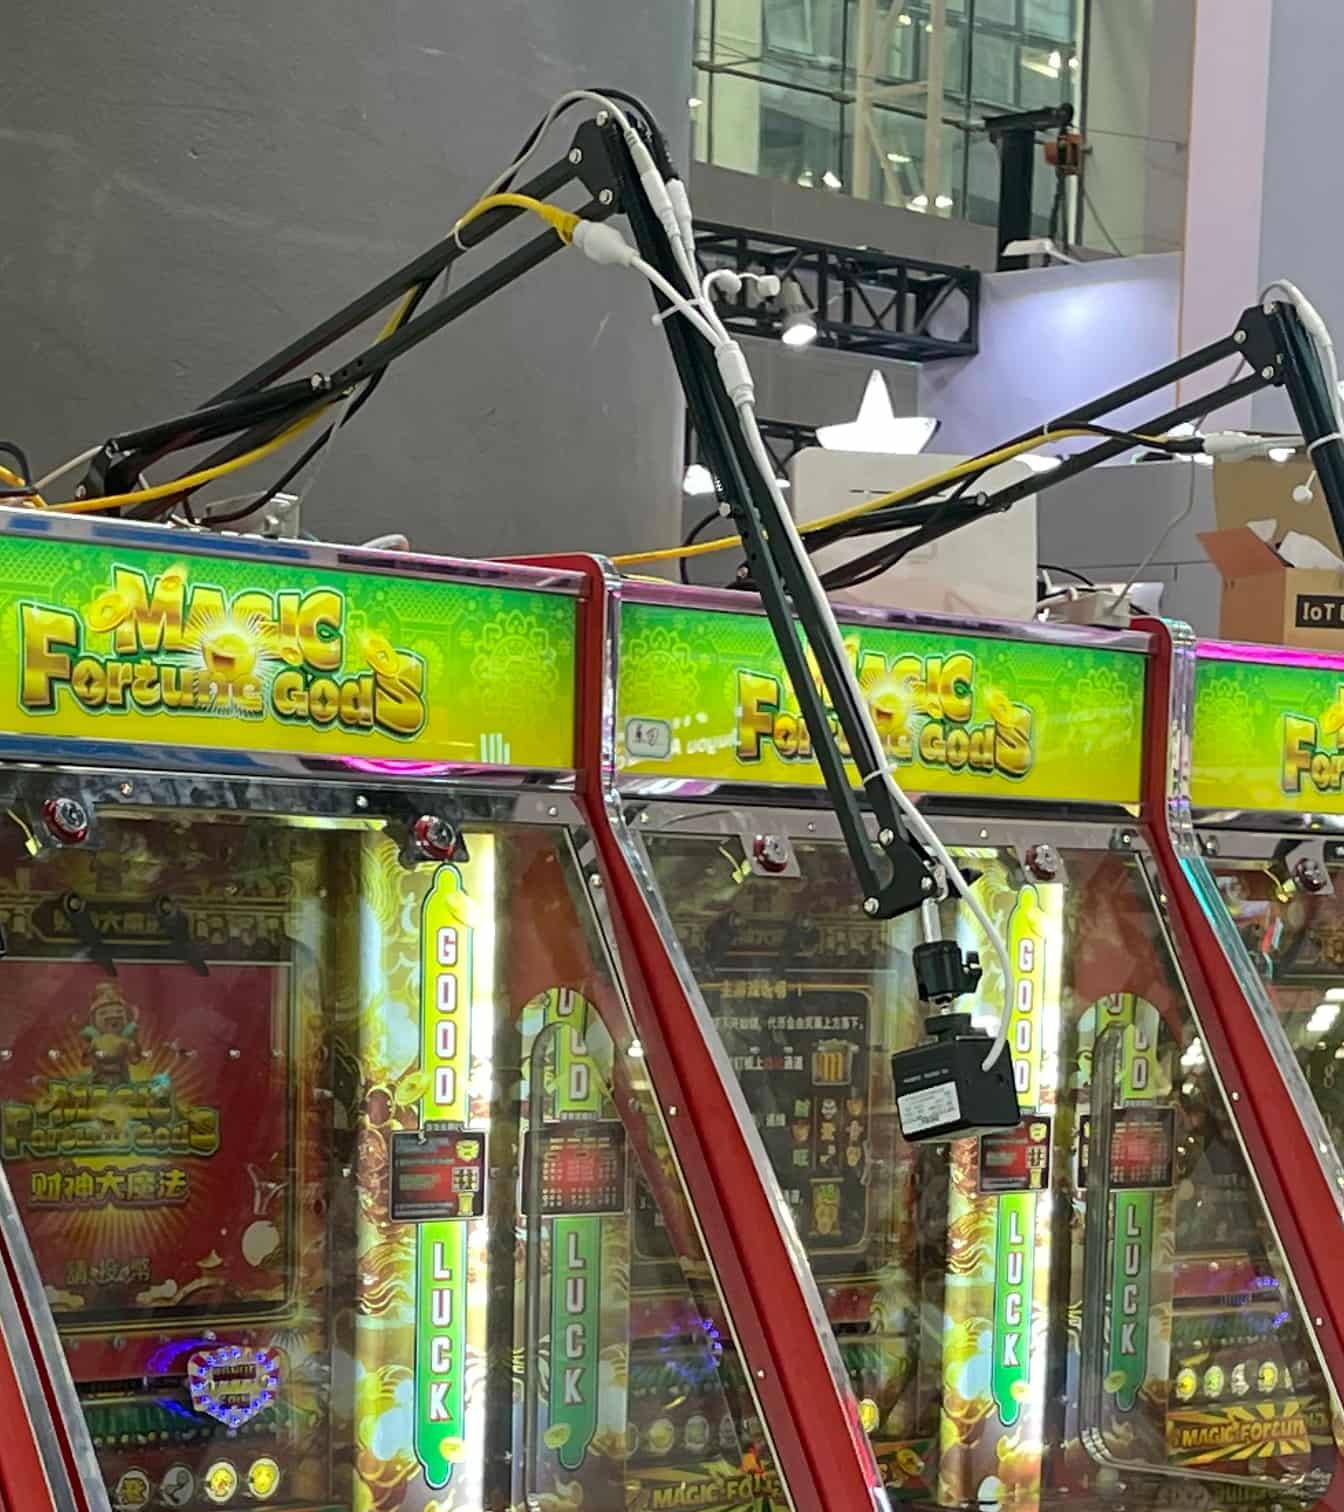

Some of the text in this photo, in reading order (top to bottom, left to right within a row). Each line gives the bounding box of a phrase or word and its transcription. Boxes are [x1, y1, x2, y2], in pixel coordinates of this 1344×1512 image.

[112, 565, 345, 671] MAGIC
[436, 926, 457, 1107] GOOD
[1014, 938, 1035, 1095] GOOD
[32, 1167, 189, 1202] 财神大魔法
[430, 1242, 454, 1421] LUCK
[565, 1231, 586, 1405] LUCK
[1002, 1211, 1023, 1368] LUCK
[1119, 1203, 1139, 1355] LUCK
